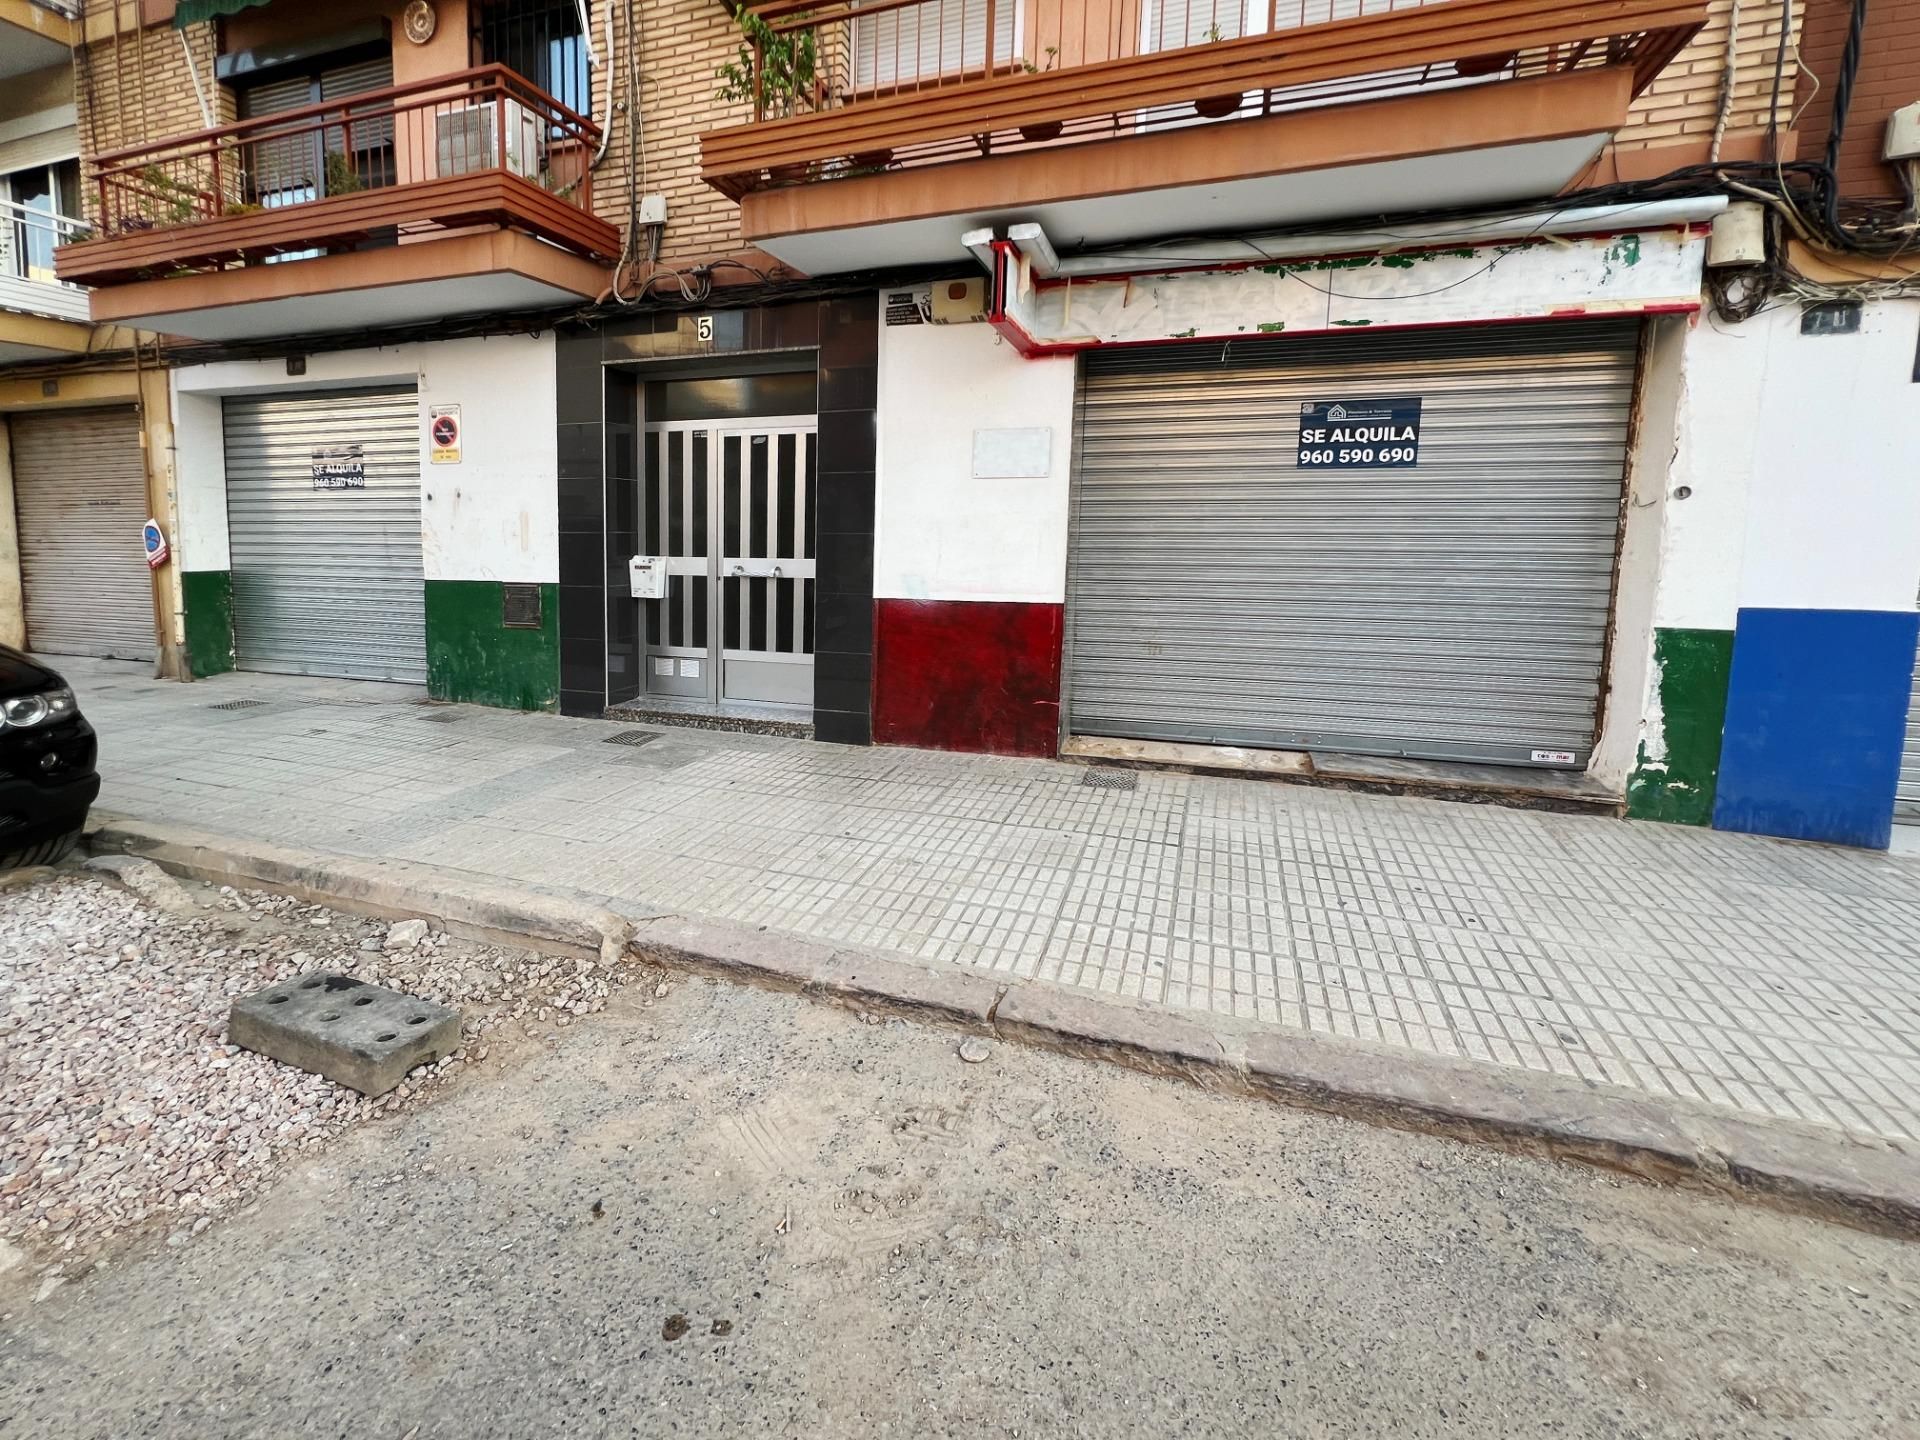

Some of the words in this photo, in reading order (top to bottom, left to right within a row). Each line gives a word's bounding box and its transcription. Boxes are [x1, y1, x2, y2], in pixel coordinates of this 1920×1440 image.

[699, 319, 711, 338] 5
[1301, 428, 1327, 443] SE
[1329, 425, 1416, 443] ALQUILA
[1299, 450, 1334, 465] 960
[1338, 448, 1374, 463] 590
[1378, 447, 1415, 463] 690
[313, 464, 325, 475] SE
[325, 463, 363, 474] ALQUILA
[314, 478, 330, 488] 960
[330, 477, 346, 487] 590
[347, 476, 364, 487] 690
